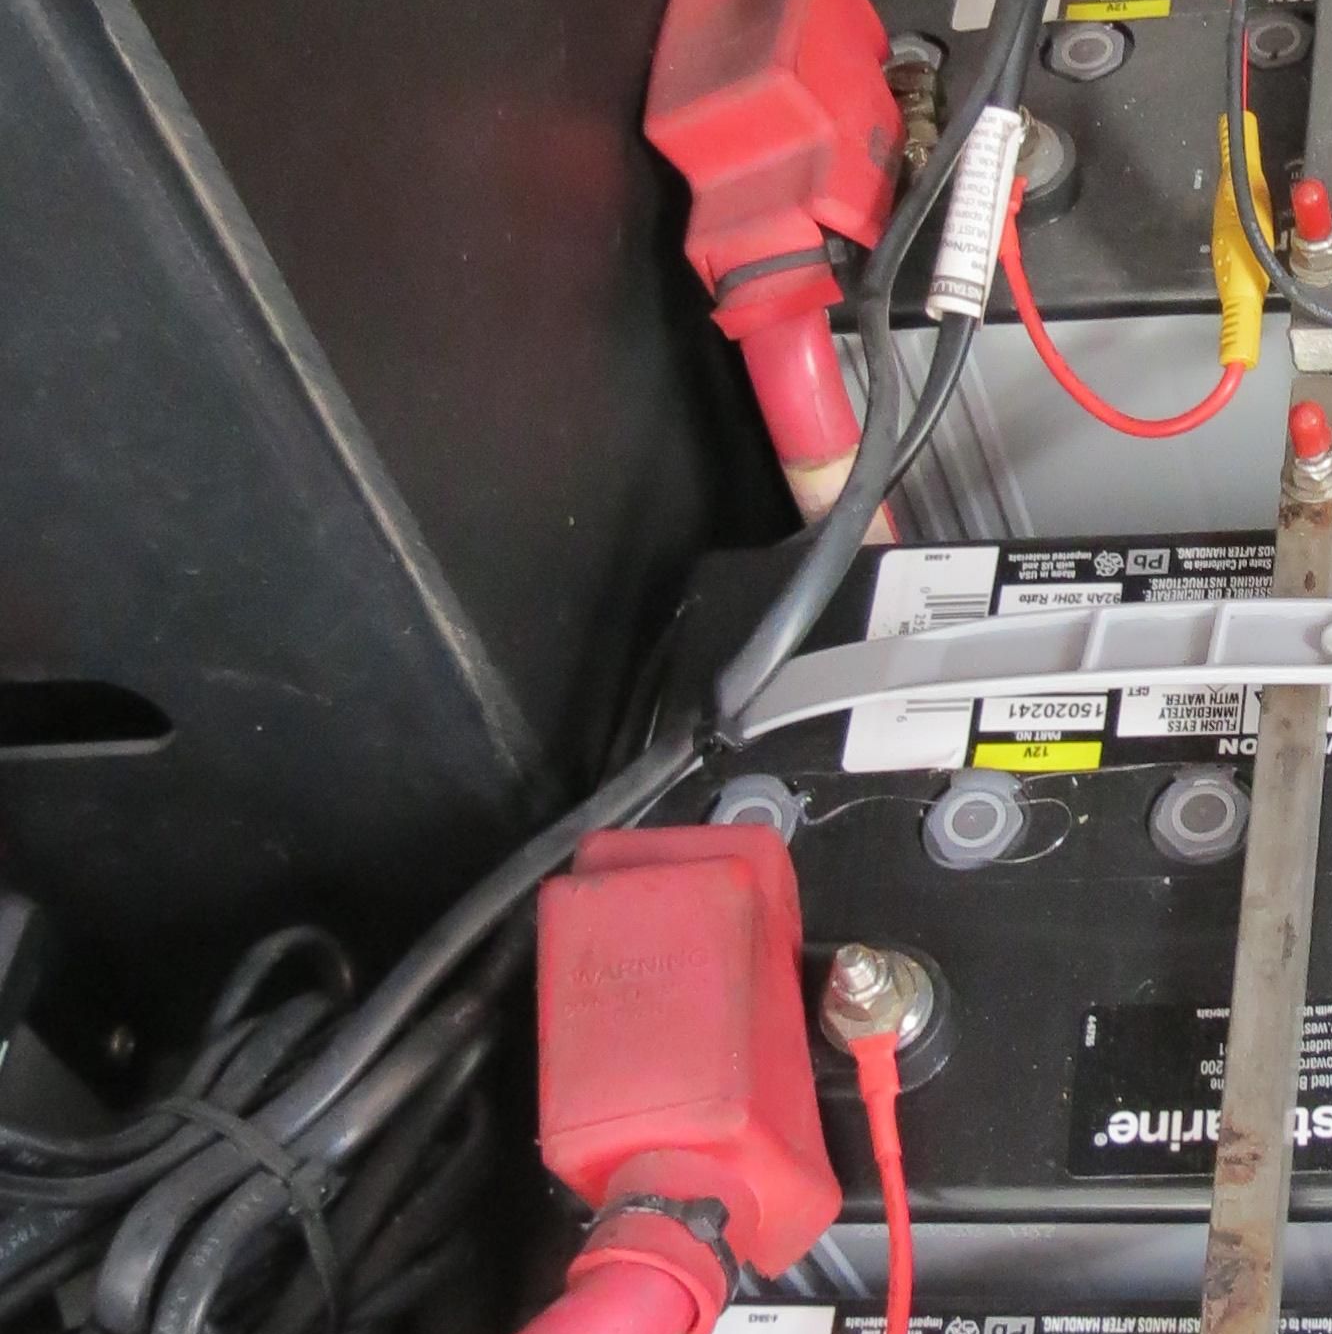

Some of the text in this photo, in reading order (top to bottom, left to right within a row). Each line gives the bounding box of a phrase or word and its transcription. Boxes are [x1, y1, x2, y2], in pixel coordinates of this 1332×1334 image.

[1106, 2, 1128, 12] 12V
[1134, 554, 1163, 570] Pb
[1018, 593, 1082, 605] 20Hr Rate
[1162, 692, 1240, 708] WITH WATER.
[1008, 702, 1104, 719] 15020241
[1158, 705, 1239, 720] IMMEDIATELY
[1167, 718, 1237, 732] FLUSH EYES
[1035, 730, 1062, 741] PART
[1024, 745, 1049, 759] 12V
[1041, 1316, 1177, 1332] HANDS AFTER HANDLING.
